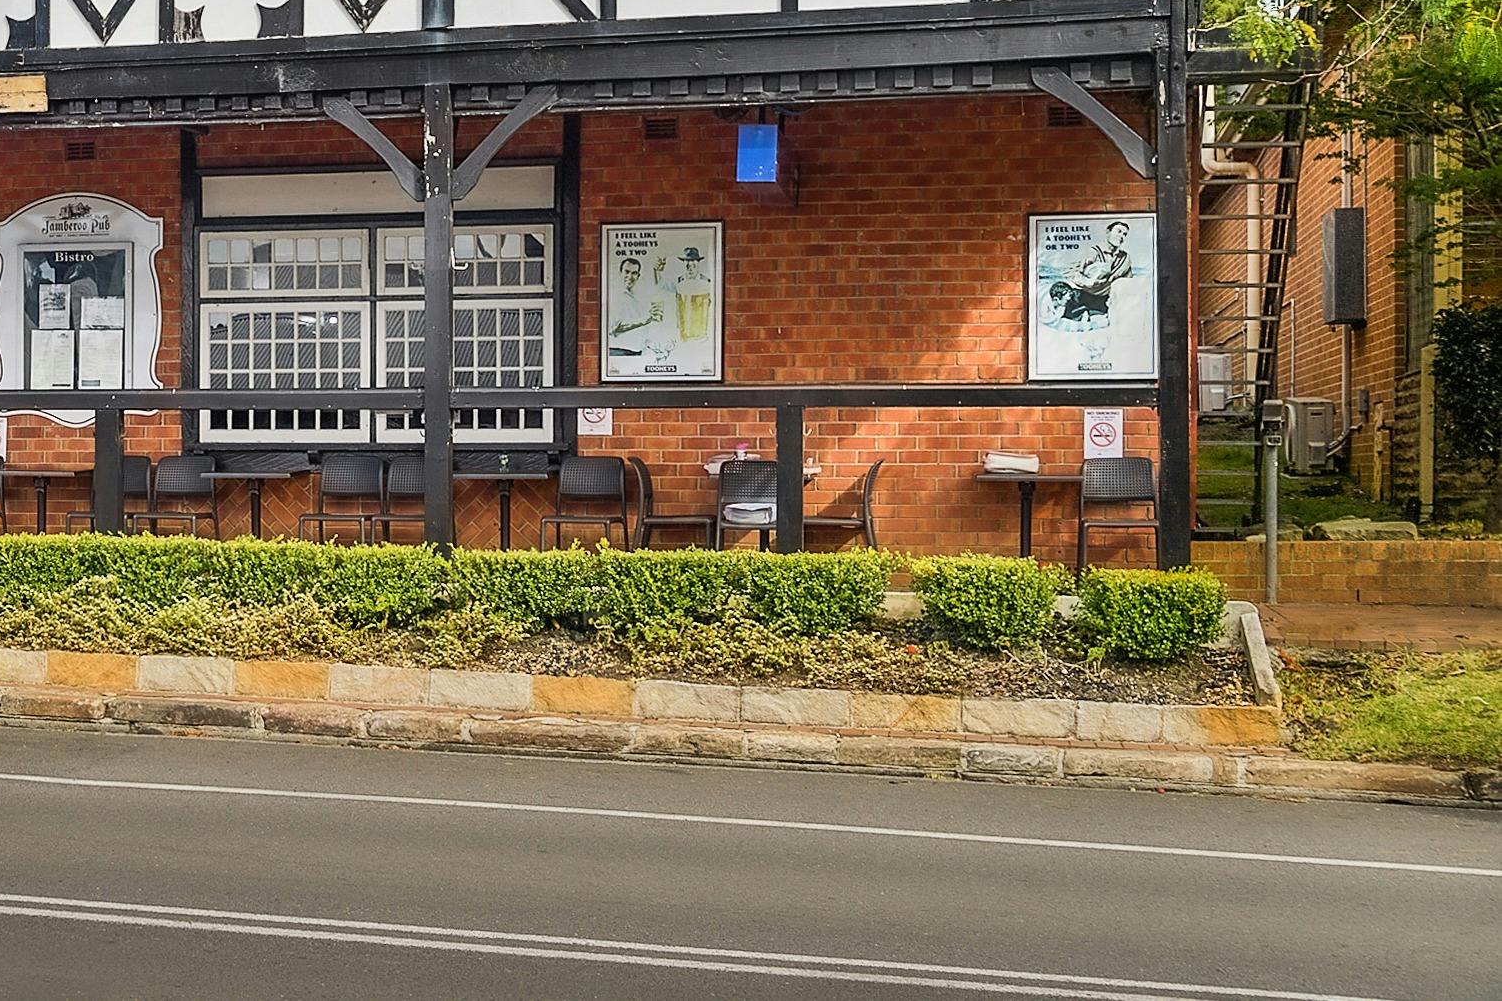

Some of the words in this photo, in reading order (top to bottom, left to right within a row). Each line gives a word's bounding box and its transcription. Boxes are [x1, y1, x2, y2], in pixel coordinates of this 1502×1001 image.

[42, 220, 88, 234] Jamberoo
[91, 219, 110, 233] Pub
[623, 240, 659, 248] TOOHEYS
[55, 251, 95, 262] Bistro
